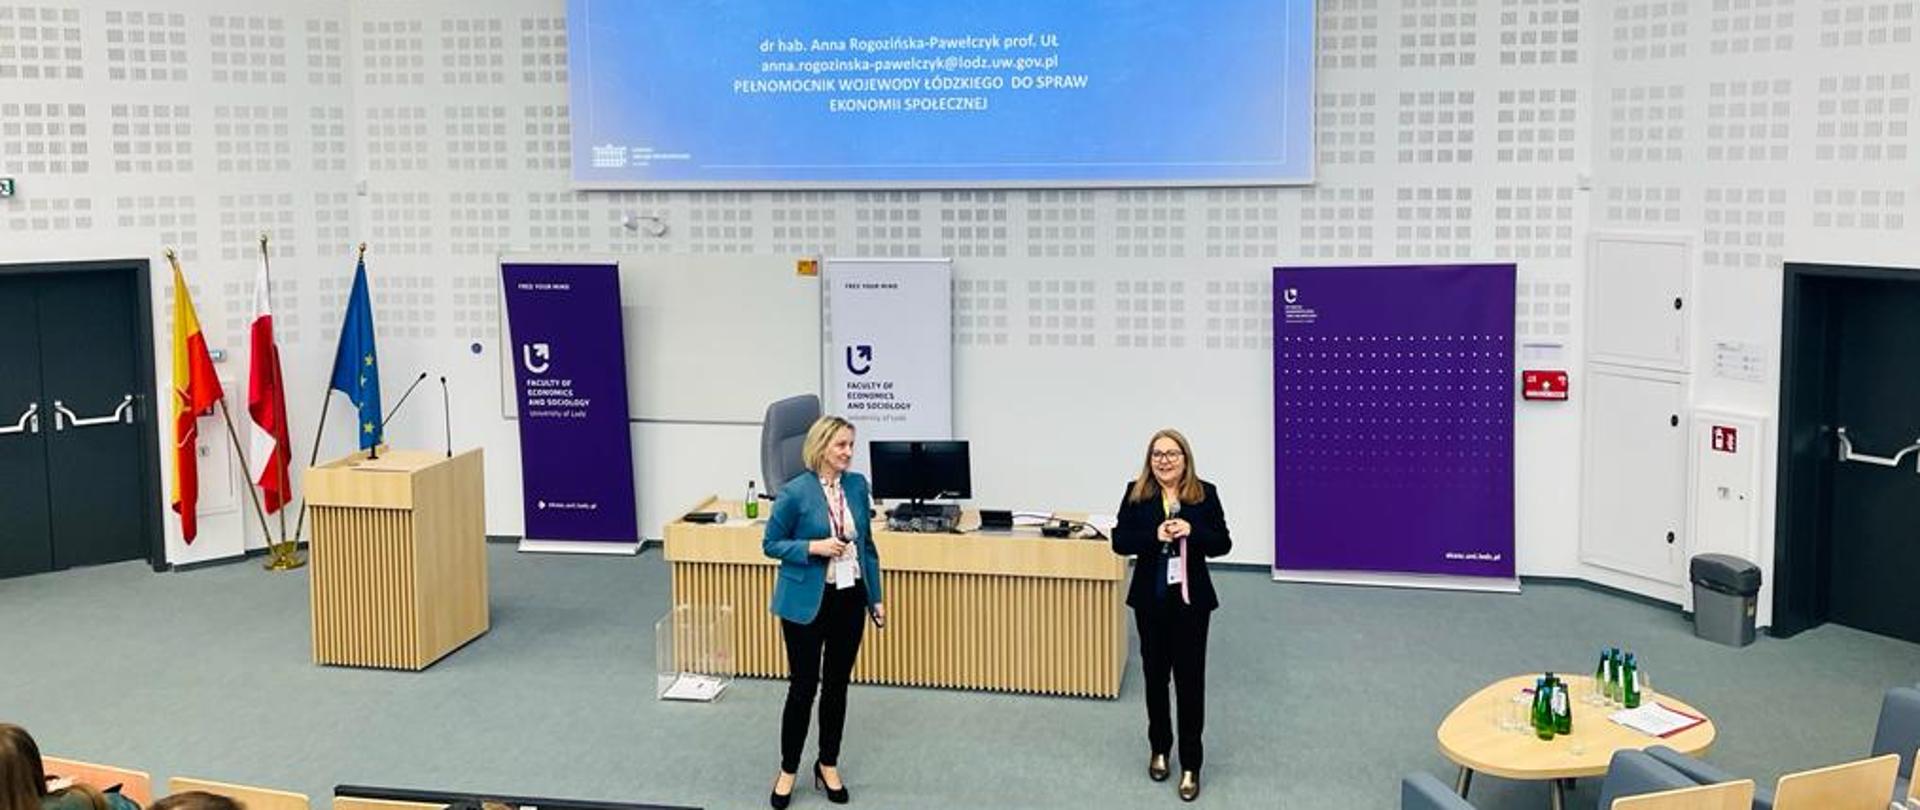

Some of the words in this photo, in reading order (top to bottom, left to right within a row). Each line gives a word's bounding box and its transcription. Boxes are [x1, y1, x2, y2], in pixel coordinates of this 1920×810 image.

[759, 39, 775, 53] dr
[778, 38, 807, 52] hab.
[811, 38, 846, 51] Anna
[1004, 34, 1035, 50] prof.
[1040, 34, 1059, 47] UŁ
[761, 54, 1058, 74] anna.rogozinska-pawelczyk@lodz.uw.gov.pl
[734, 79, 835, 93] PEŁNOMOCNIK
[838, 78, 920, 92] WOJEWODY
[924, 75, 1003, 90] ŁÓDZKIEGO
[1011, 76, 1033, 89] DO
[1036, 75, 1088, 89] SPRAW
[829, 98, 901, 112] EKONOMII
[904, 97, 988, 111] SPOŁECZNEJ
[847, 382, 881, 390] FACULTY
[883, 382, 894, 390] OF
[527, 389, 574, 397] ECONOMICS
[847, 392, 894, 400] ECONOMICS
[547, 399, 590, 407] SOCIOLOGY
[847, 402, 865, 410] AND
[867, 402, 911, 410] SOCIOLOGY
